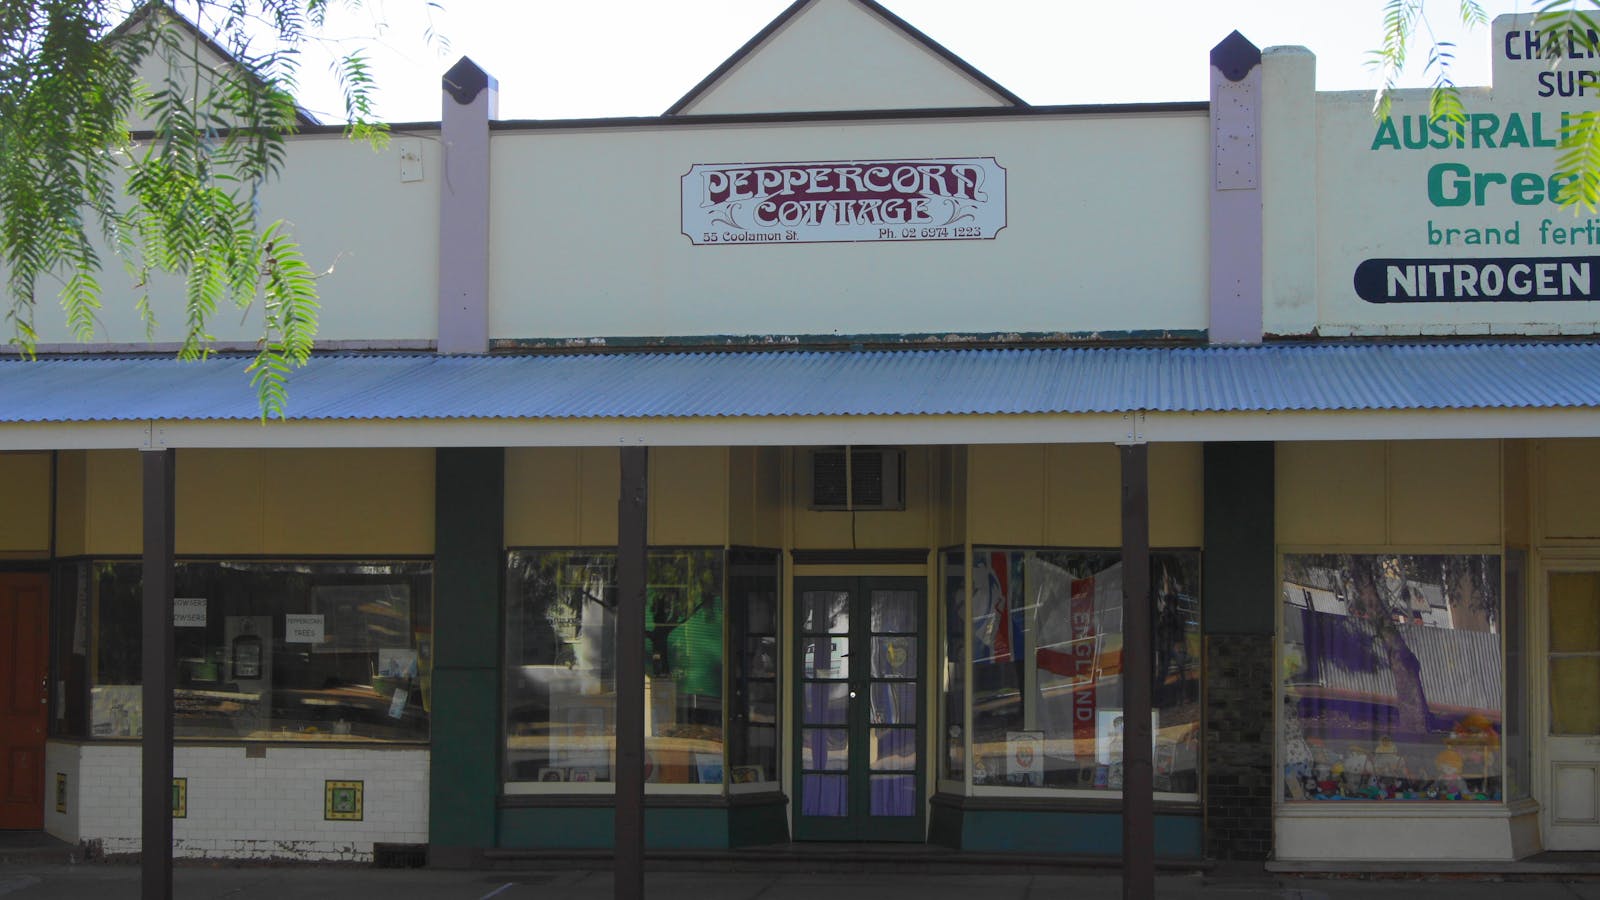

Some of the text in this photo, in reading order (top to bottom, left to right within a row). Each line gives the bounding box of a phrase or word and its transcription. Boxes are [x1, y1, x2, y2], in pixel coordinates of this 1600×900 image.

[1371, 111, 1600, 150] AUSTRALI
[700, 165, 988, 207] PEPPERCORN
[753, 194, 934, 227] COTTAGE
[703, 232, 718, 242] 55
[722, 231, 782, 242] Coolamon
[879, 226, 982, 239] Ph. 02 6974 1223
[1427, 218, 1600, 245] brand ferti
[1387, 262, 1591, 298] NITROGEN
[1074, 612, 1093, 721] ENGLAND
